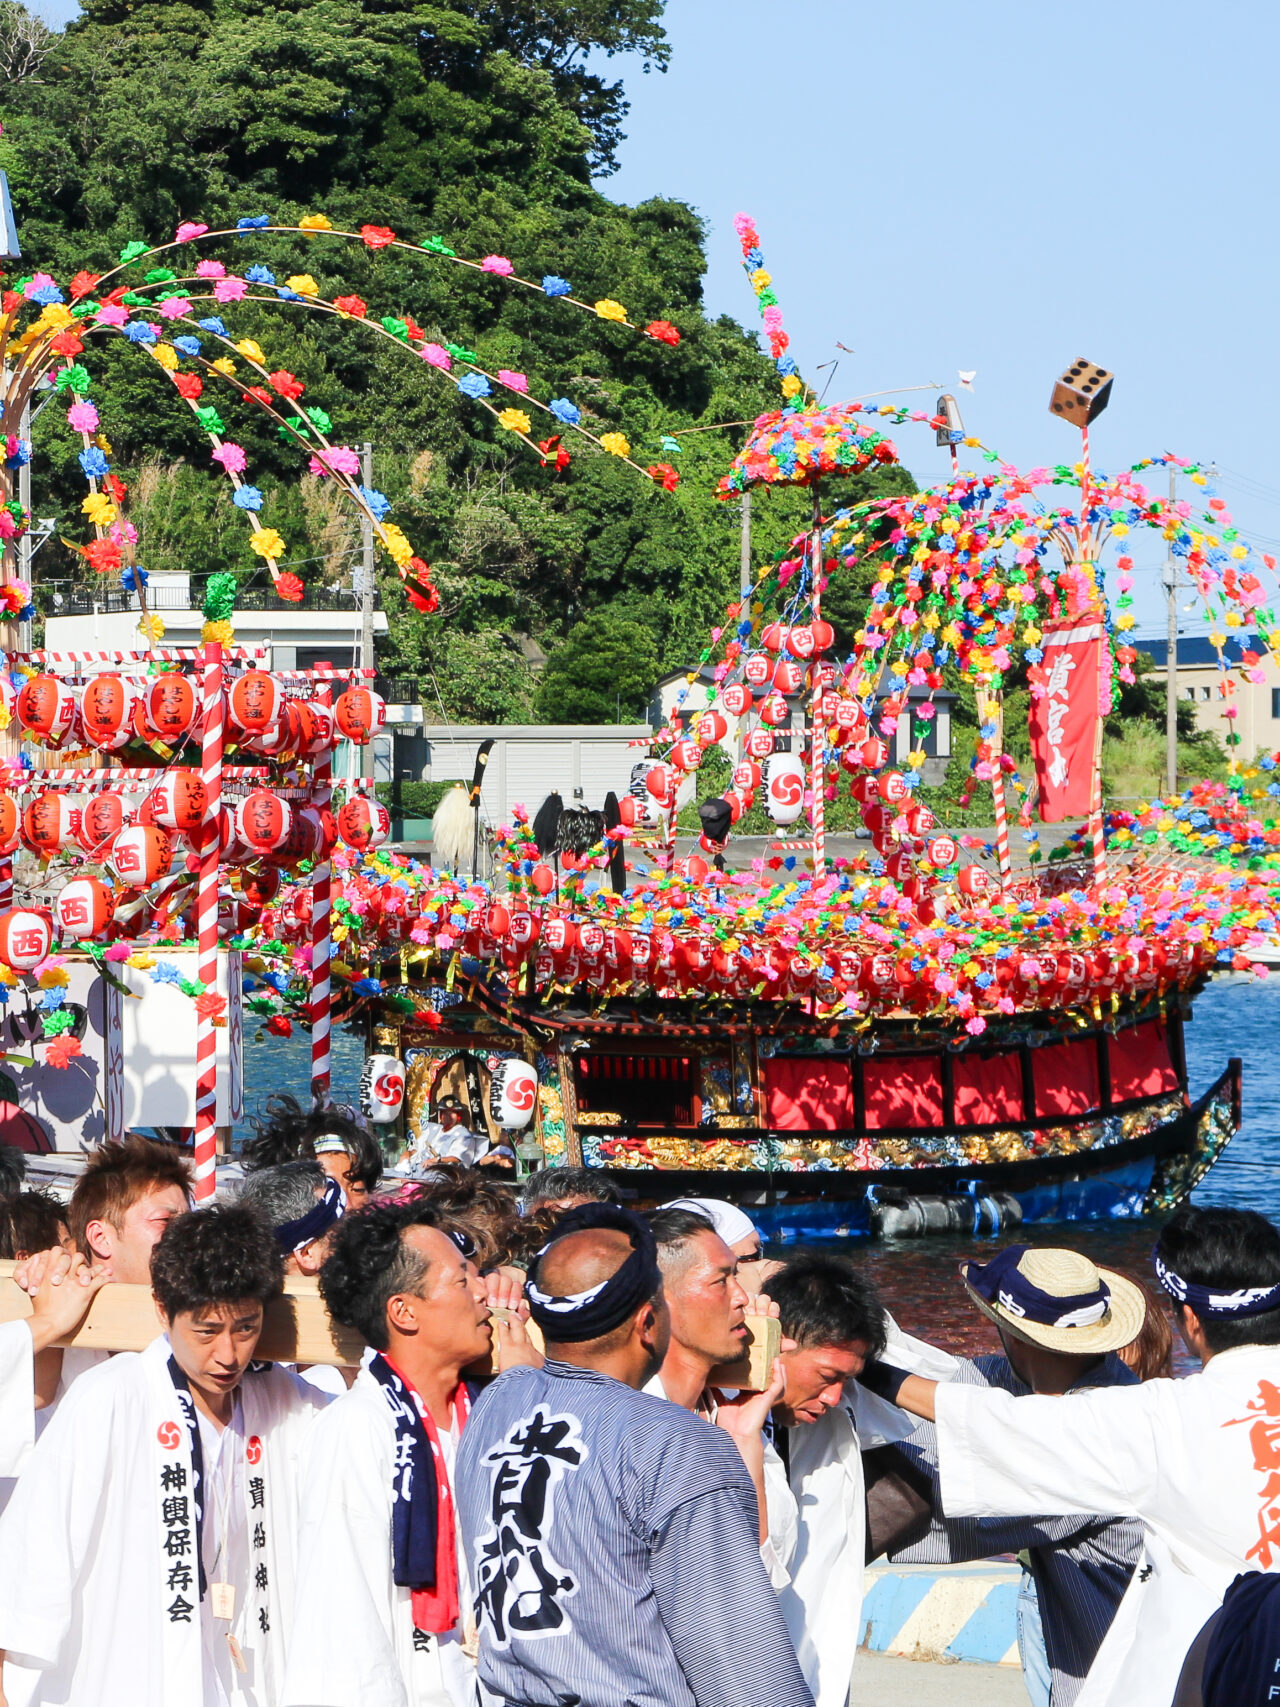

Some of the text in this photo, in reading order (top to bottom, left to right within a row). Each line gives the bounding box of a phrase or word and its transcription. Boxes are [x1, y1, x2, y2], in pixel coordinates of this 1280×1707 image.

[794, 630, 812, 647] 西
[747, 661, 766, 677] 西
[790, 666, 803, 683] 西
[25, 686, 47, 723] はやし連
[93, 687, 114, 725] はやし連
[161, 686, 184, 725] はやし連
[244, 680, 265, 719] はやし連
[725, 689, 742, 706] 西
[775, 702, 788, 718] 西
[840, 704, 858, 721] 西
[698, 719, 712, 735] 西
[754, 735, 772, 751] 西
[685, 746, 701, 763] 西
[735, 767, 751, 784] 西
[890, 778, 907, 795] 西
[185, 782, 205, 821] はやし連
[31, 802, 52, 841] はやし連
[251, 800, 274, 840] はやし連
[114, 843, 141, 873] 西
[935, 843, 953, 860] 西
[60, 896, 88, 926] 西
[545, 926, 564, 942] 西
[583, 928, 603, 945] 西
[12, 928, 43, 958] 西
[160, 1462, 194, 1624] 神輿保存会
